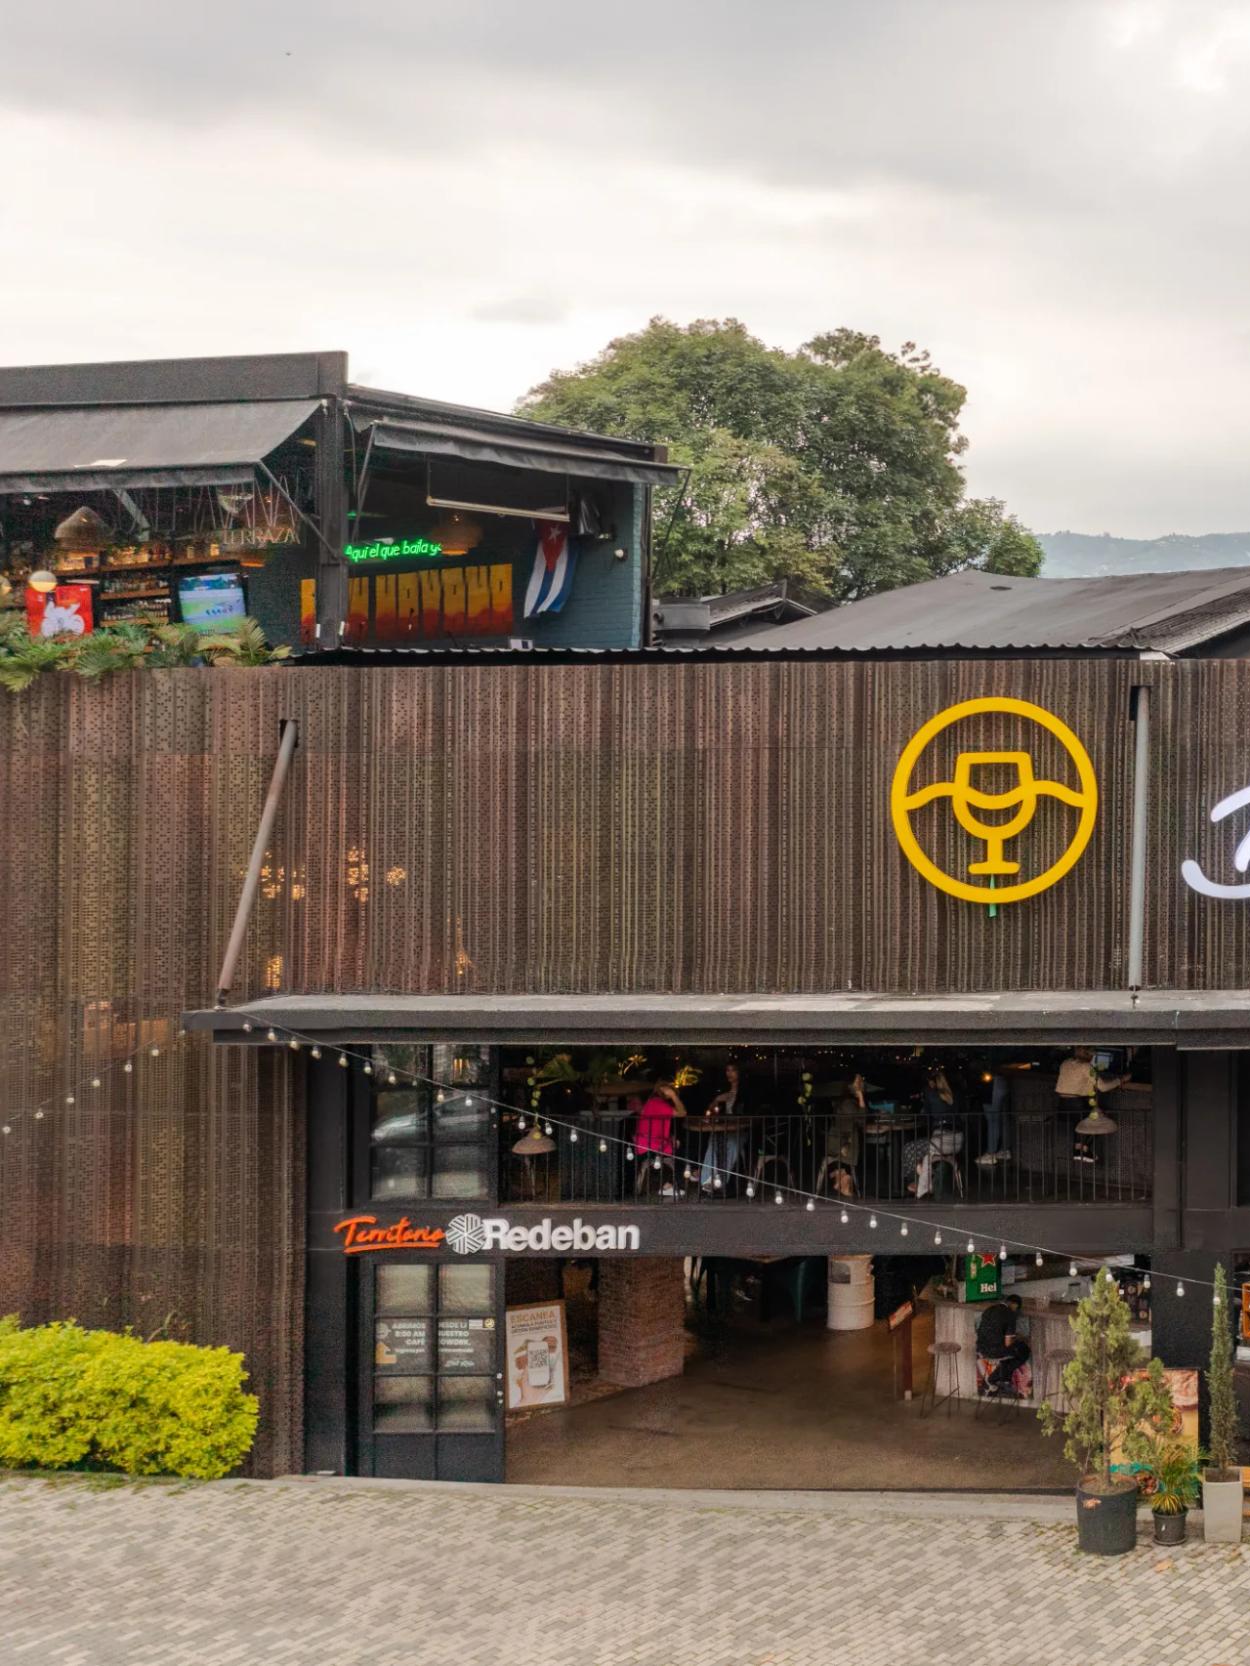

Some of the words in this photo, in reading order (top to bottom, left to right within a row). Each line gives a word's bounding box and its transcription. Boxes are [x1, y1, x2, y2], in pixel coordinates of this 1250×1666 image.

[369, 543, 380, 558] el
[380, 545, 401, 560] que
[402, 539, 429, 554] baila
[334, 1216, 446, 1250] Territorio
[483, 1218, 640, 1250] Redeban
